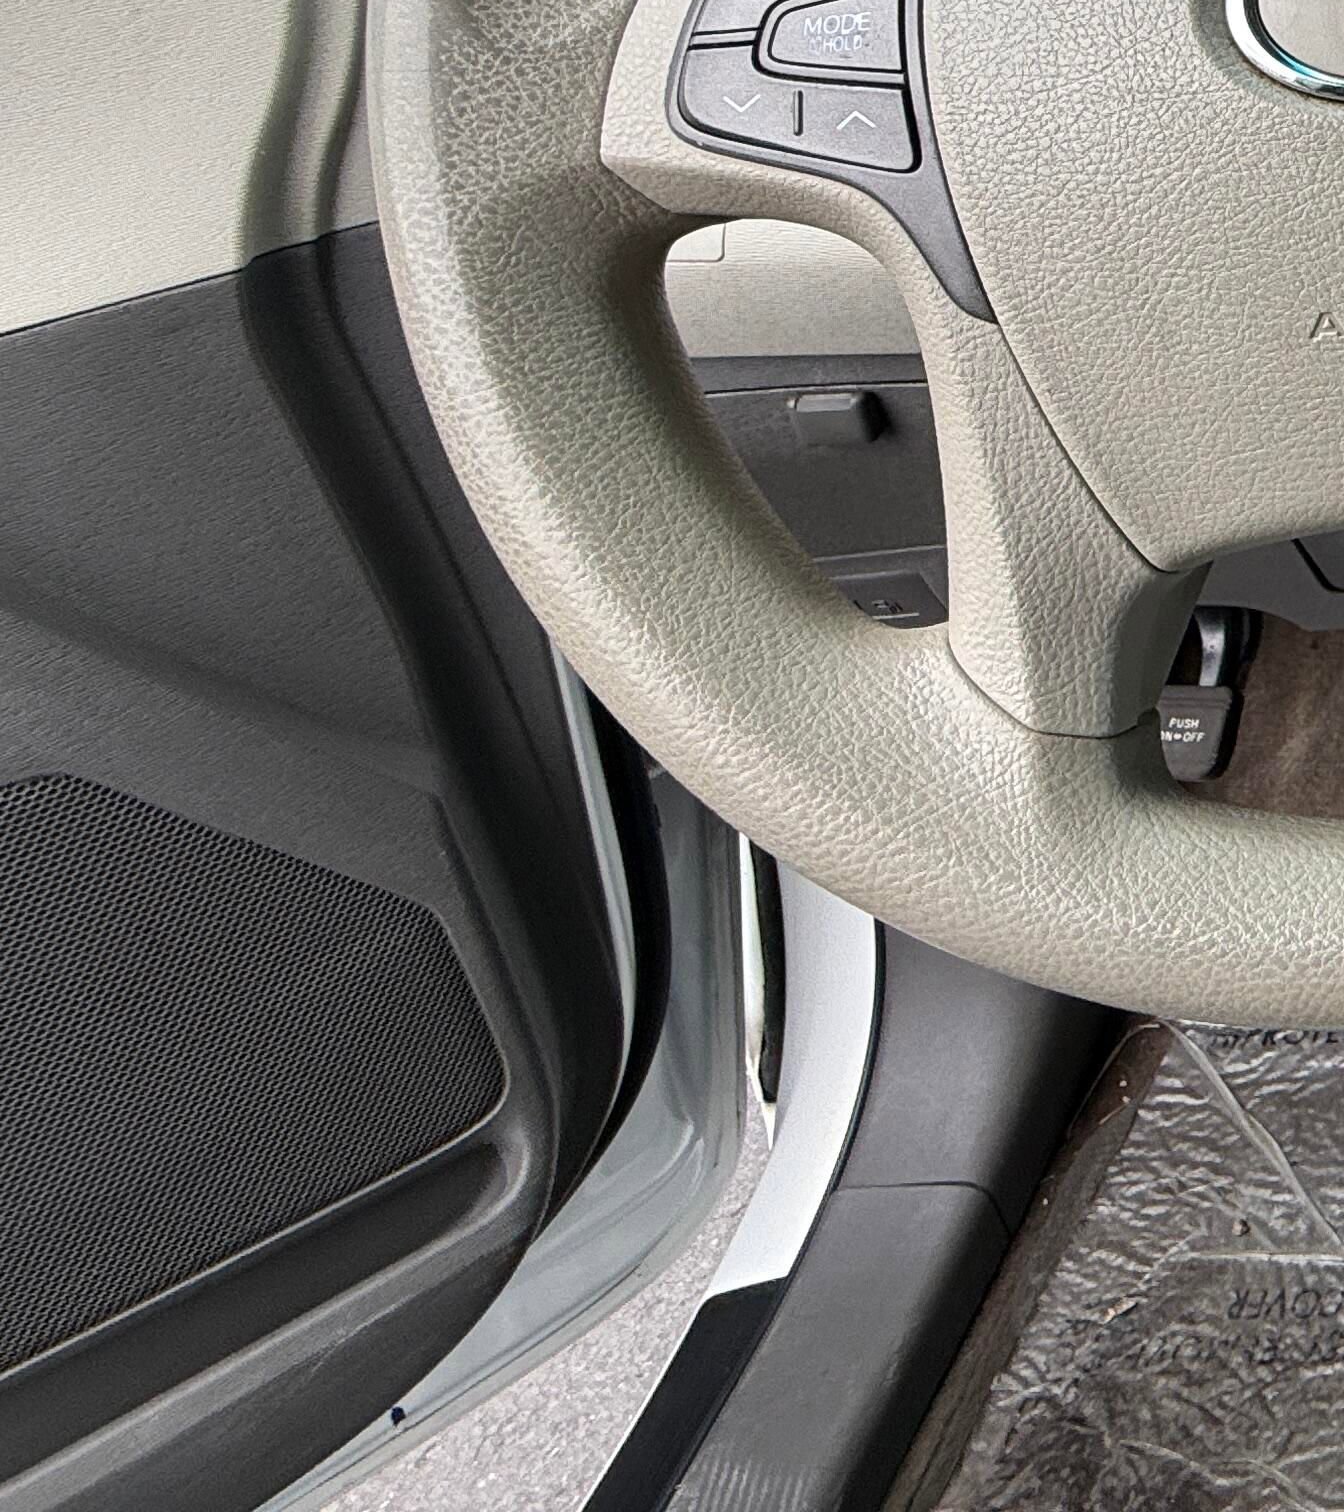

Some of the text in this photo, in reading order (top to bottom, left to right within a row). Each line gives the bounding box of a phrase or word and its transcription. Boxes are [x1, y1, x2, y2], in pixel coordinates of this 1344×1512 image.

[803, 11, 872, 36] MODE
[823, 34, 863, 52] HOLD
[1168, 717, 1200, 729] PUSH
